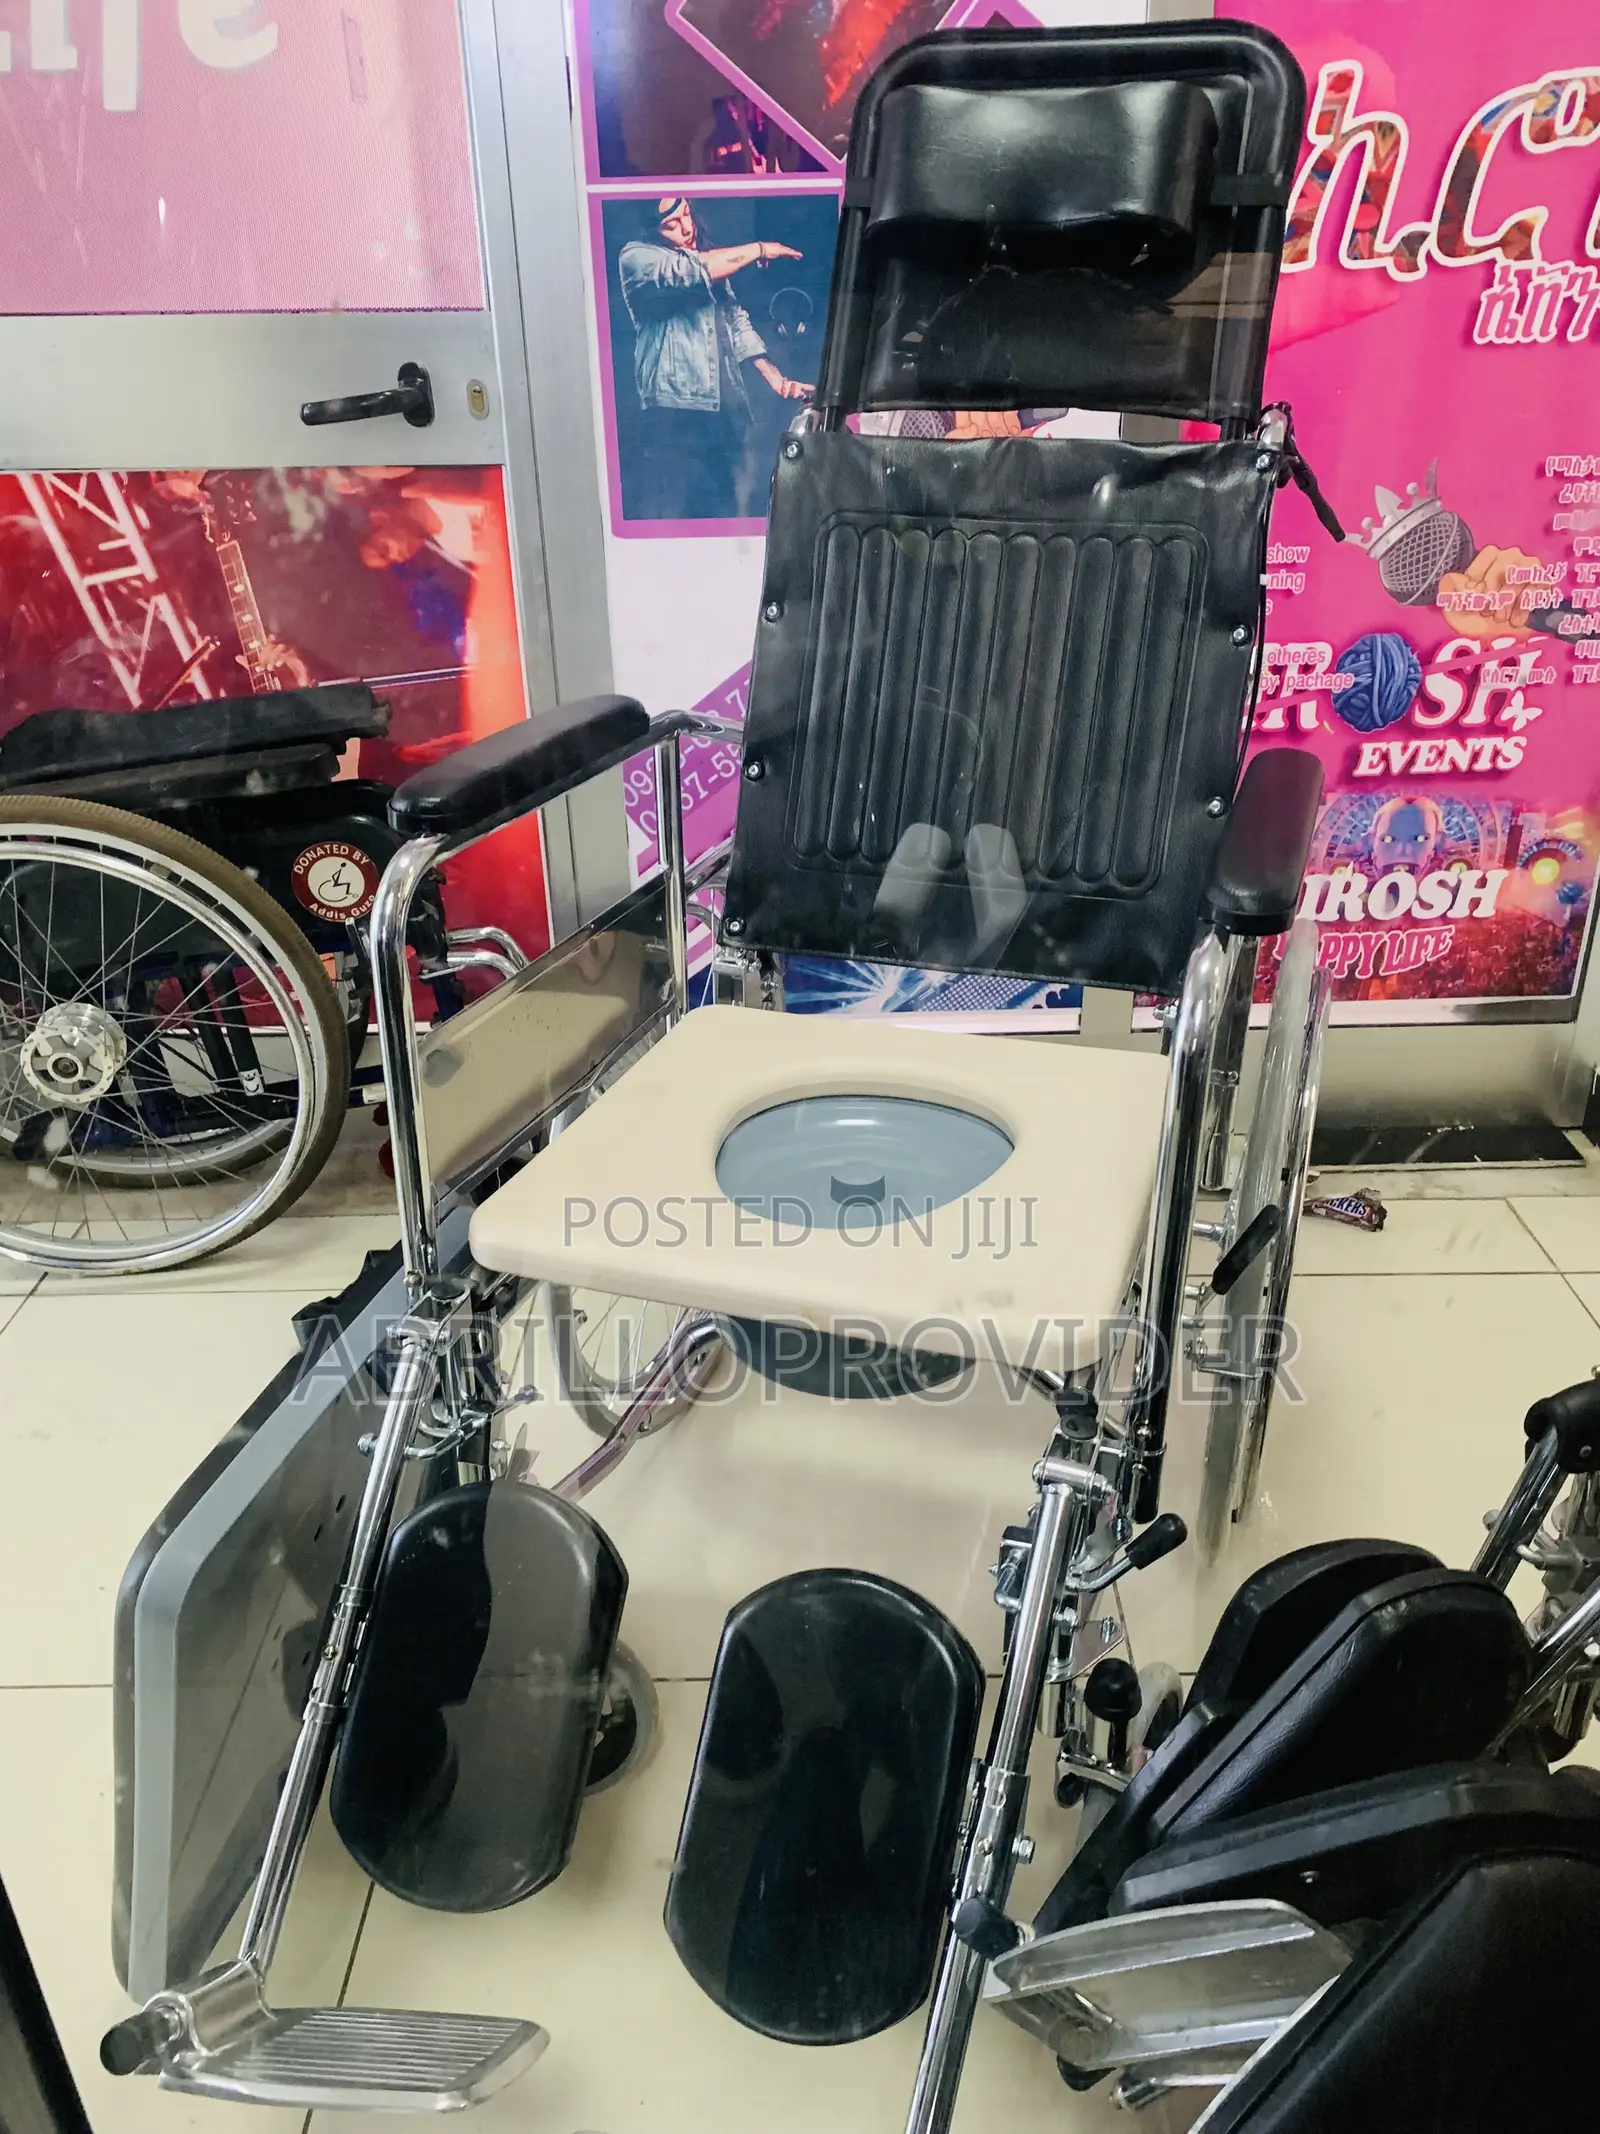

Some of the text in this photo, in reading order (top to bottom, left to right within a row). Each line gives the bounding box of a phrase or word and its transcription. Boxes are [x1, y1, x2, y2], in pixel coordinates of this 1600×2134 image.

[1266, 543, 1310, 564] show
[1266, 569, 1306, 594] ning
[1353, 736, 1528, 777] EVENTS
[294, 844, 370, 875] DONATED BY
[309, 894, 375, 920] Addis Guzo
[1379, 924, 1456, 976] LIFE
